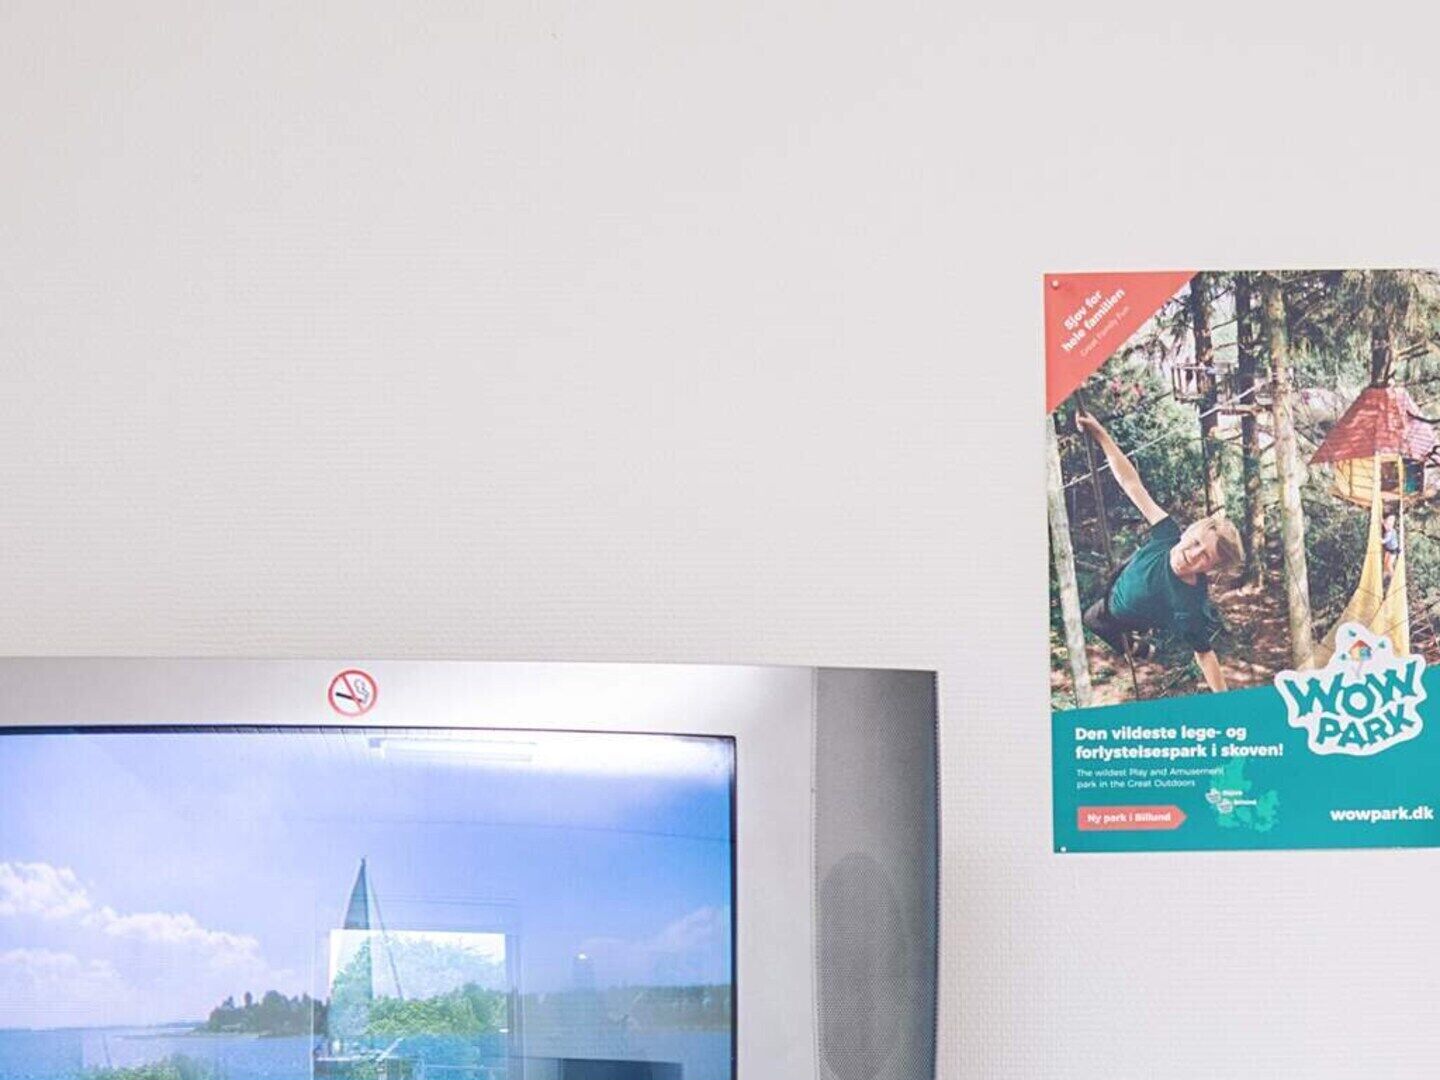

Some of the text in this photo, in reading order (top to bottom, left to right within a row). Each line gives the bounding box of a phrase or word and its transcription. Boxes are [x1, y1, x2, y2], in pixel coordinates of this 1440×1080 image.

[1064, 290, 1102, 330] Sjov for
[1061, 288, 1126, 352] hele familien
[1284, 661, 1417, 718] WOW
[1075, 725, 1247, 741] Den vildeste lege- og
[1316, 704, 1415, 749] PARK
[1075, 743, 1284, 761] forlystelsespark i skoven!
[1077, 766, 1224, 778] The wildest Play and Amusement
[1077, 781, 1096, 790] park
[1099, 780, 1108, 788] in
[1110, 780, 1125, 788] the
[1154, 779, 1195, 788] Outdoors
[1087, 811, 1171, 825] Ny park i Billund
[1330, 805, 1434, 823] wowpark.dk
